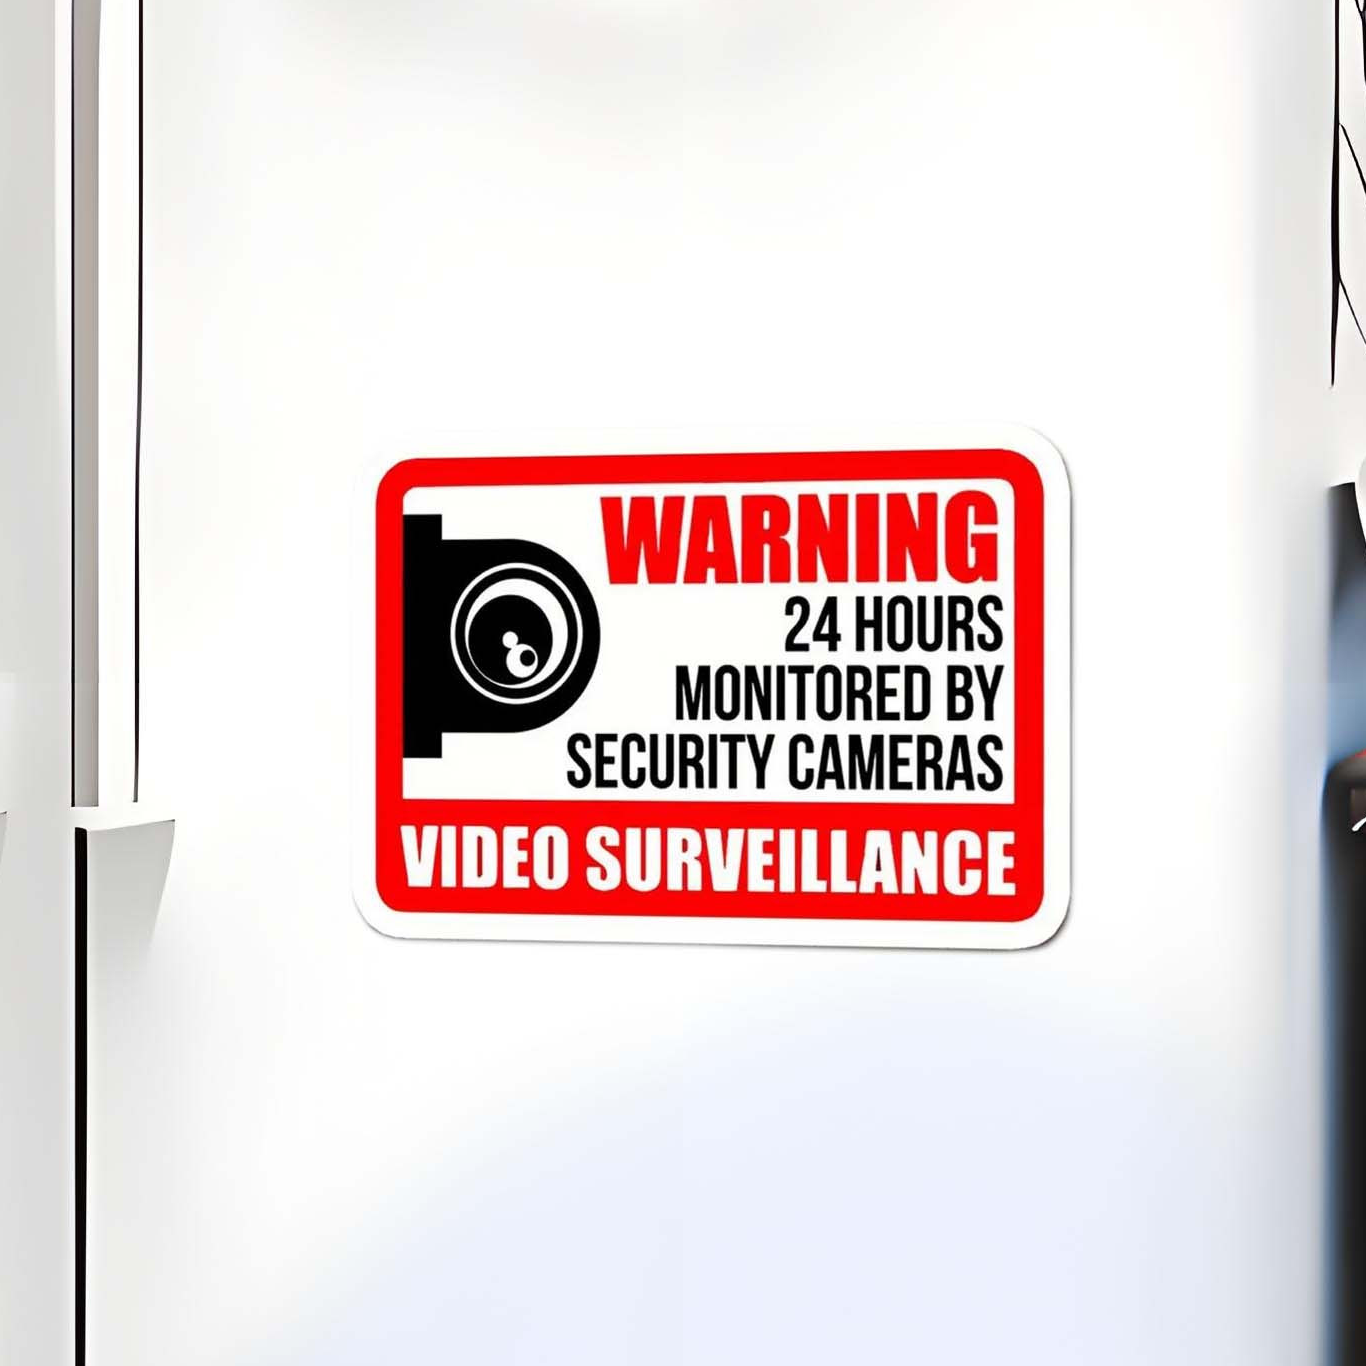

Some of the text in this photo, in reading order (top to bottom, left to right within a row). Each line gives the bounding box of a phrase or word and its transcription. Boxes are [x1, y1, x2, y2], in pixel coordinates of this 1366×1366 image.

[601, 491, 998, 584] WARNING
[785, 595, 1003, 652] 24 HOURS
[676, 665, 1004, 721] MONITORED BY
[567, 733, 1003, 791] SECURITY CAMERAS
[401, 826, 1015, 895] VIDEO SURVEILLANCE
